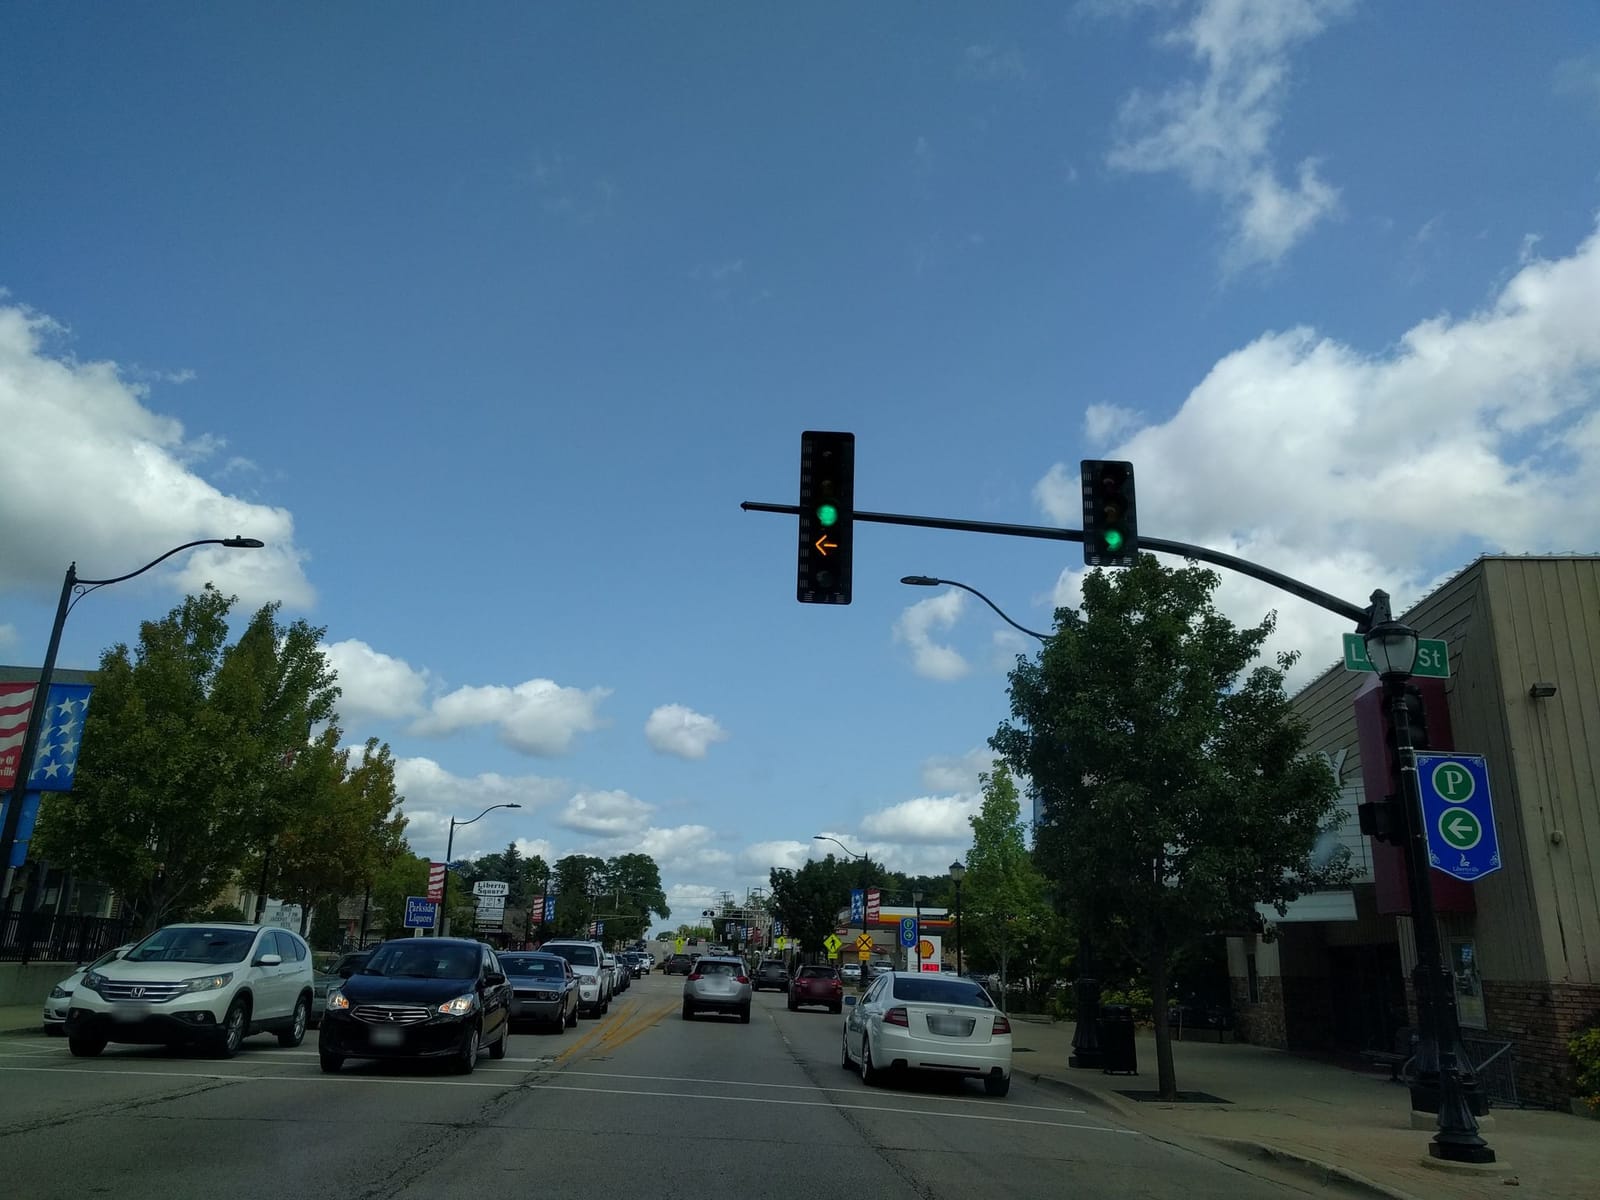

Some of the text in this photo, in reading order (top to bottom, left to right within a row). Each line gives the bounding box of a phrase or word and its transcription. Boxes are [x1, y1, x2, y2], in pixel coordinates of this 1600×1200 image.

[1418, 647, 1441, 668] St
[1444, 770, 1463, 795] P
[477, 882, 506, 890] Liberty
[409, 901, 434, 912] Parkside
[409, 911, 432, 925] Liquors
